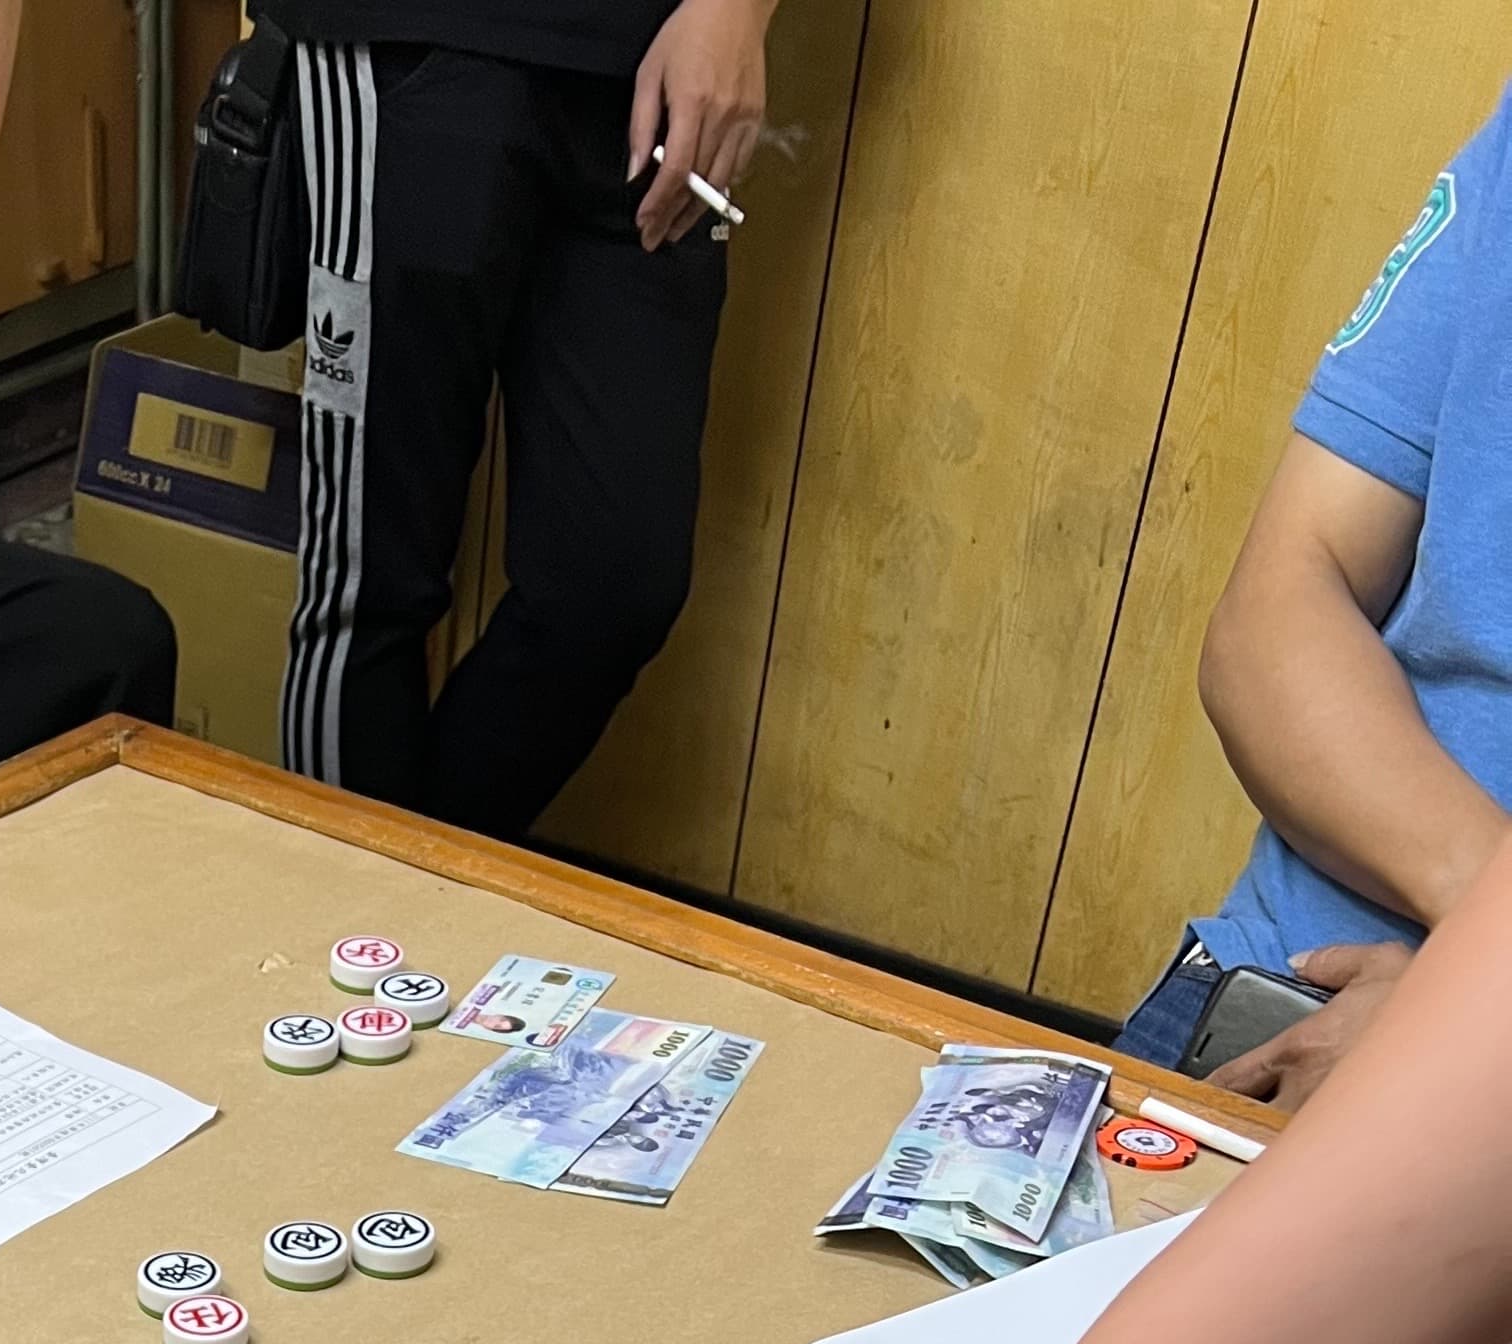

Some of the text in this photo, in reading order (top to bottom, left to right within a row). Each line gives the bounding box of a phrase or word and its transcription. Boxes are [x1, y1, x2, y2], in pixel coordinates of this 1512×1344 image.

[652, 1030, 691, 1058] 1000
[704, 1038, 753, 1083] 1000
[885, 1146, 933, 1192] 1000
[1012, 1183, 1041, 1222] 1000
